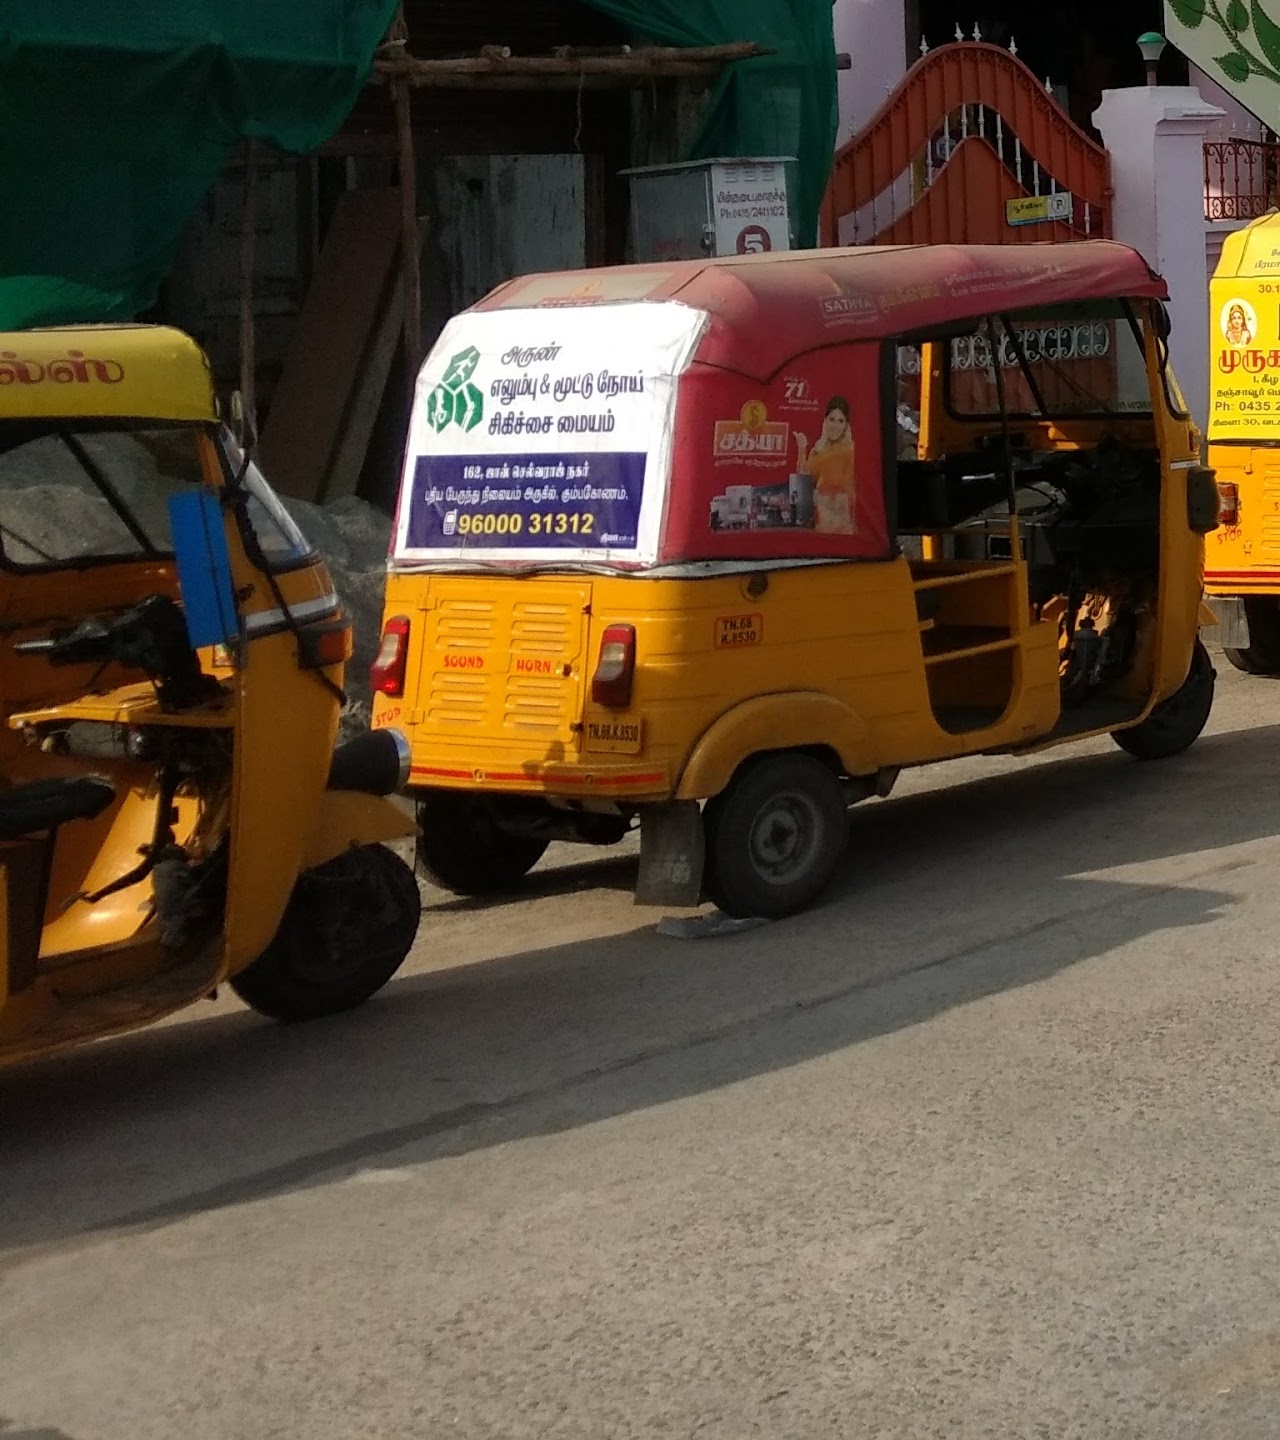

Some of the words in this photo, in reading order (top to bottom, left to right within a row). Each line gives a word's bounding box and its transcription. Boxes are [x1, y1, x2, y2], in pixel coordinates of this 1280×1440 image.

[745, 233, 763, 254] 5
[823, 298, 873, 312] SATHYA
[501, 341, 563, 368] அருண்
[491, 373, 538, 405] எலும்பு
[540, 373, 550, 394] &
[554, 373, 593, 402] மூட்டு
[597, 369, 644, 400] நோய்
[784, 382, 805, 397] 71
[1216, 387, 1265, 398] தஞ்சாவூர்
[1215, 402, 1234, 411] Ph:
[1239, 402, 1271, 411] 0435
[488, 411, 554, 435] சிகிச்சை
[558, 408, 615, 433] மையம்
[720, 428, 783, 451] சத்யா
[463, 465, 483, 480] 162,
[486, 463, 509, 479] ஜான்
[512, 461, 564, 479] செல்வராஜ்
[566, 461, 590, 480] நகர்
[445, 486, 480, 505] பேருந்து
[482, 485, 522, 506] நிலையம்
[458, 513, 522, 534] 96000
[529, 513, 594, 534] 31312
[1217, 529, 1242, 545] STOP
[722, 619, 752, 631] TN.68
[443, 655, 485, 669] SOUND
[516, 659, 552, 673] HORN
